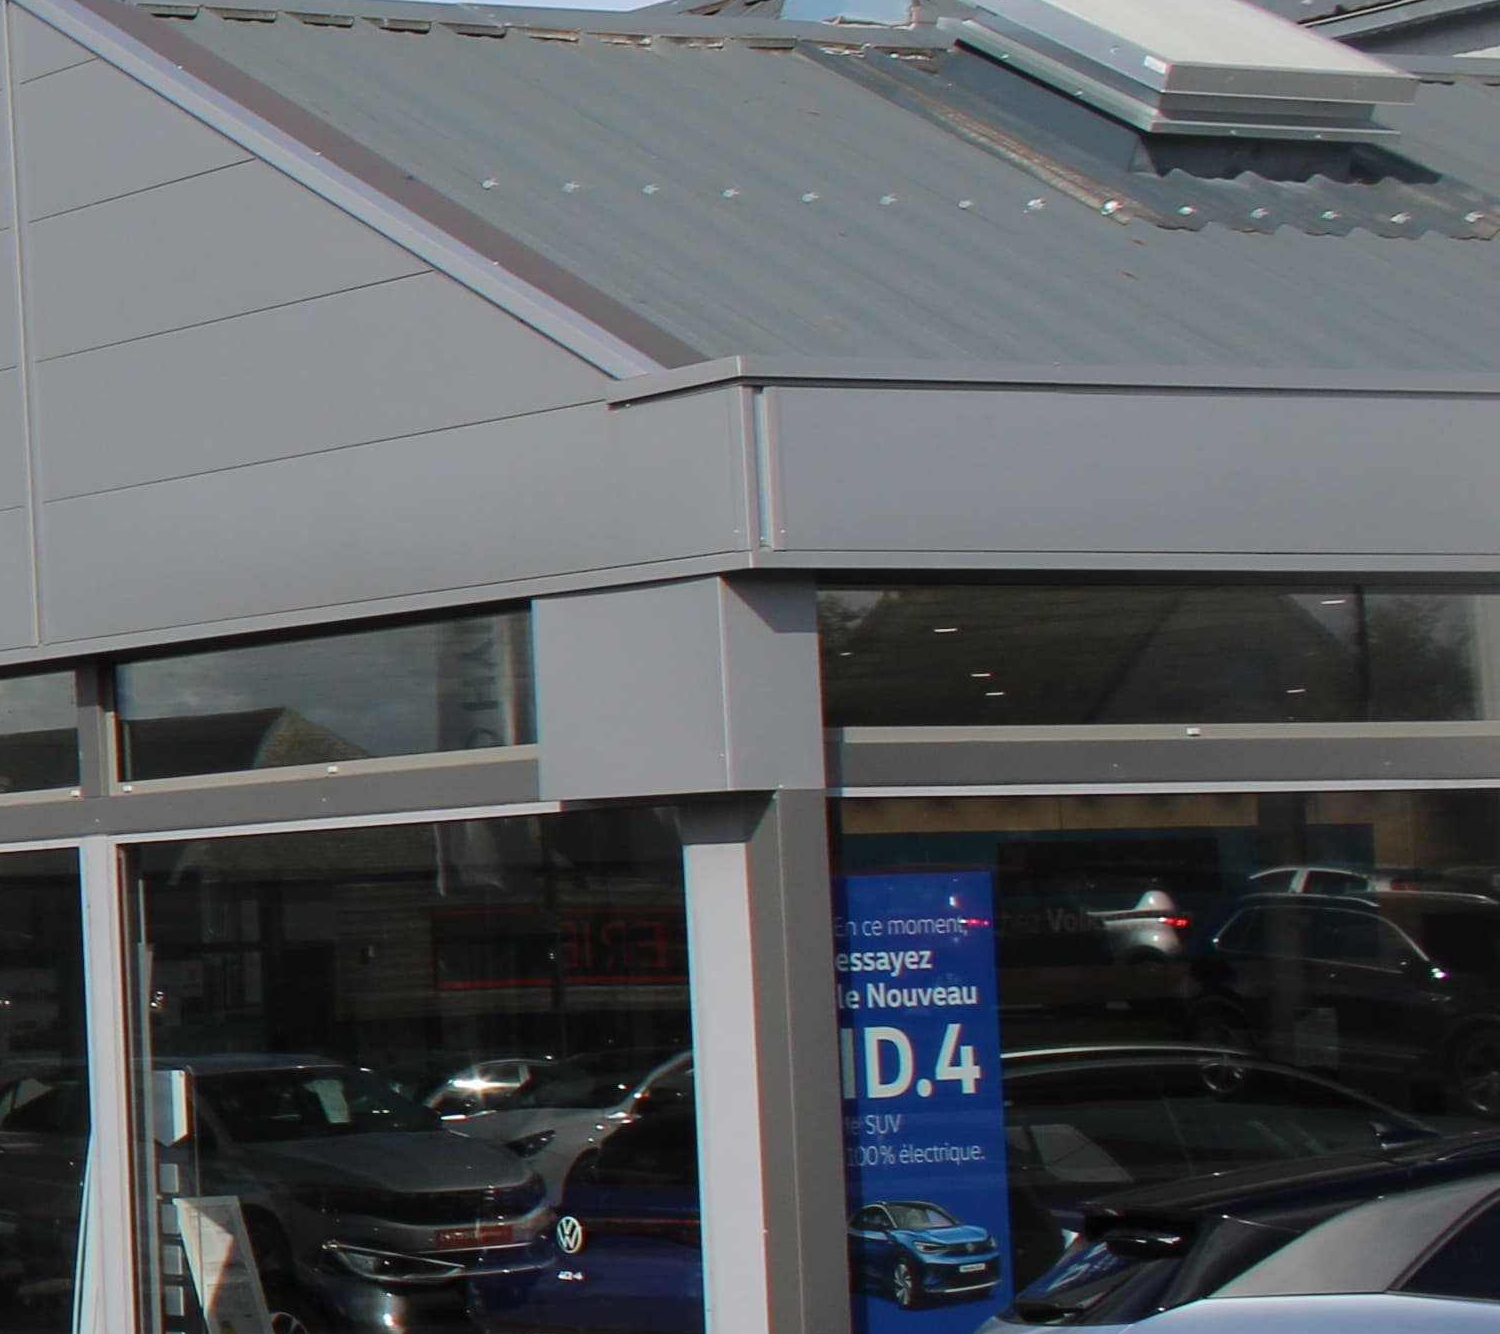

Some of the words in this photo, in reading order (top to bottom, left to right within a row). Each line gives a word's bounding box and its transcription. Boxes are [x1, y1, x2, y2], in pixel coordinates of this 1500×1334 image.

[835, 917, 857, 937] En
[862, 920, 883, 936] ce
[888, 917, 968, 936] moment,
[836, 950, 933, 976] essayez
[838, 984, 860, 1009] le
[866, 982, 978, 1008] Nouveau
[840, 1023, 981, 1099] ID.4
[865, 1114, 901, 1135] SUV
[899, 1142, 985, 1165] électrique.
